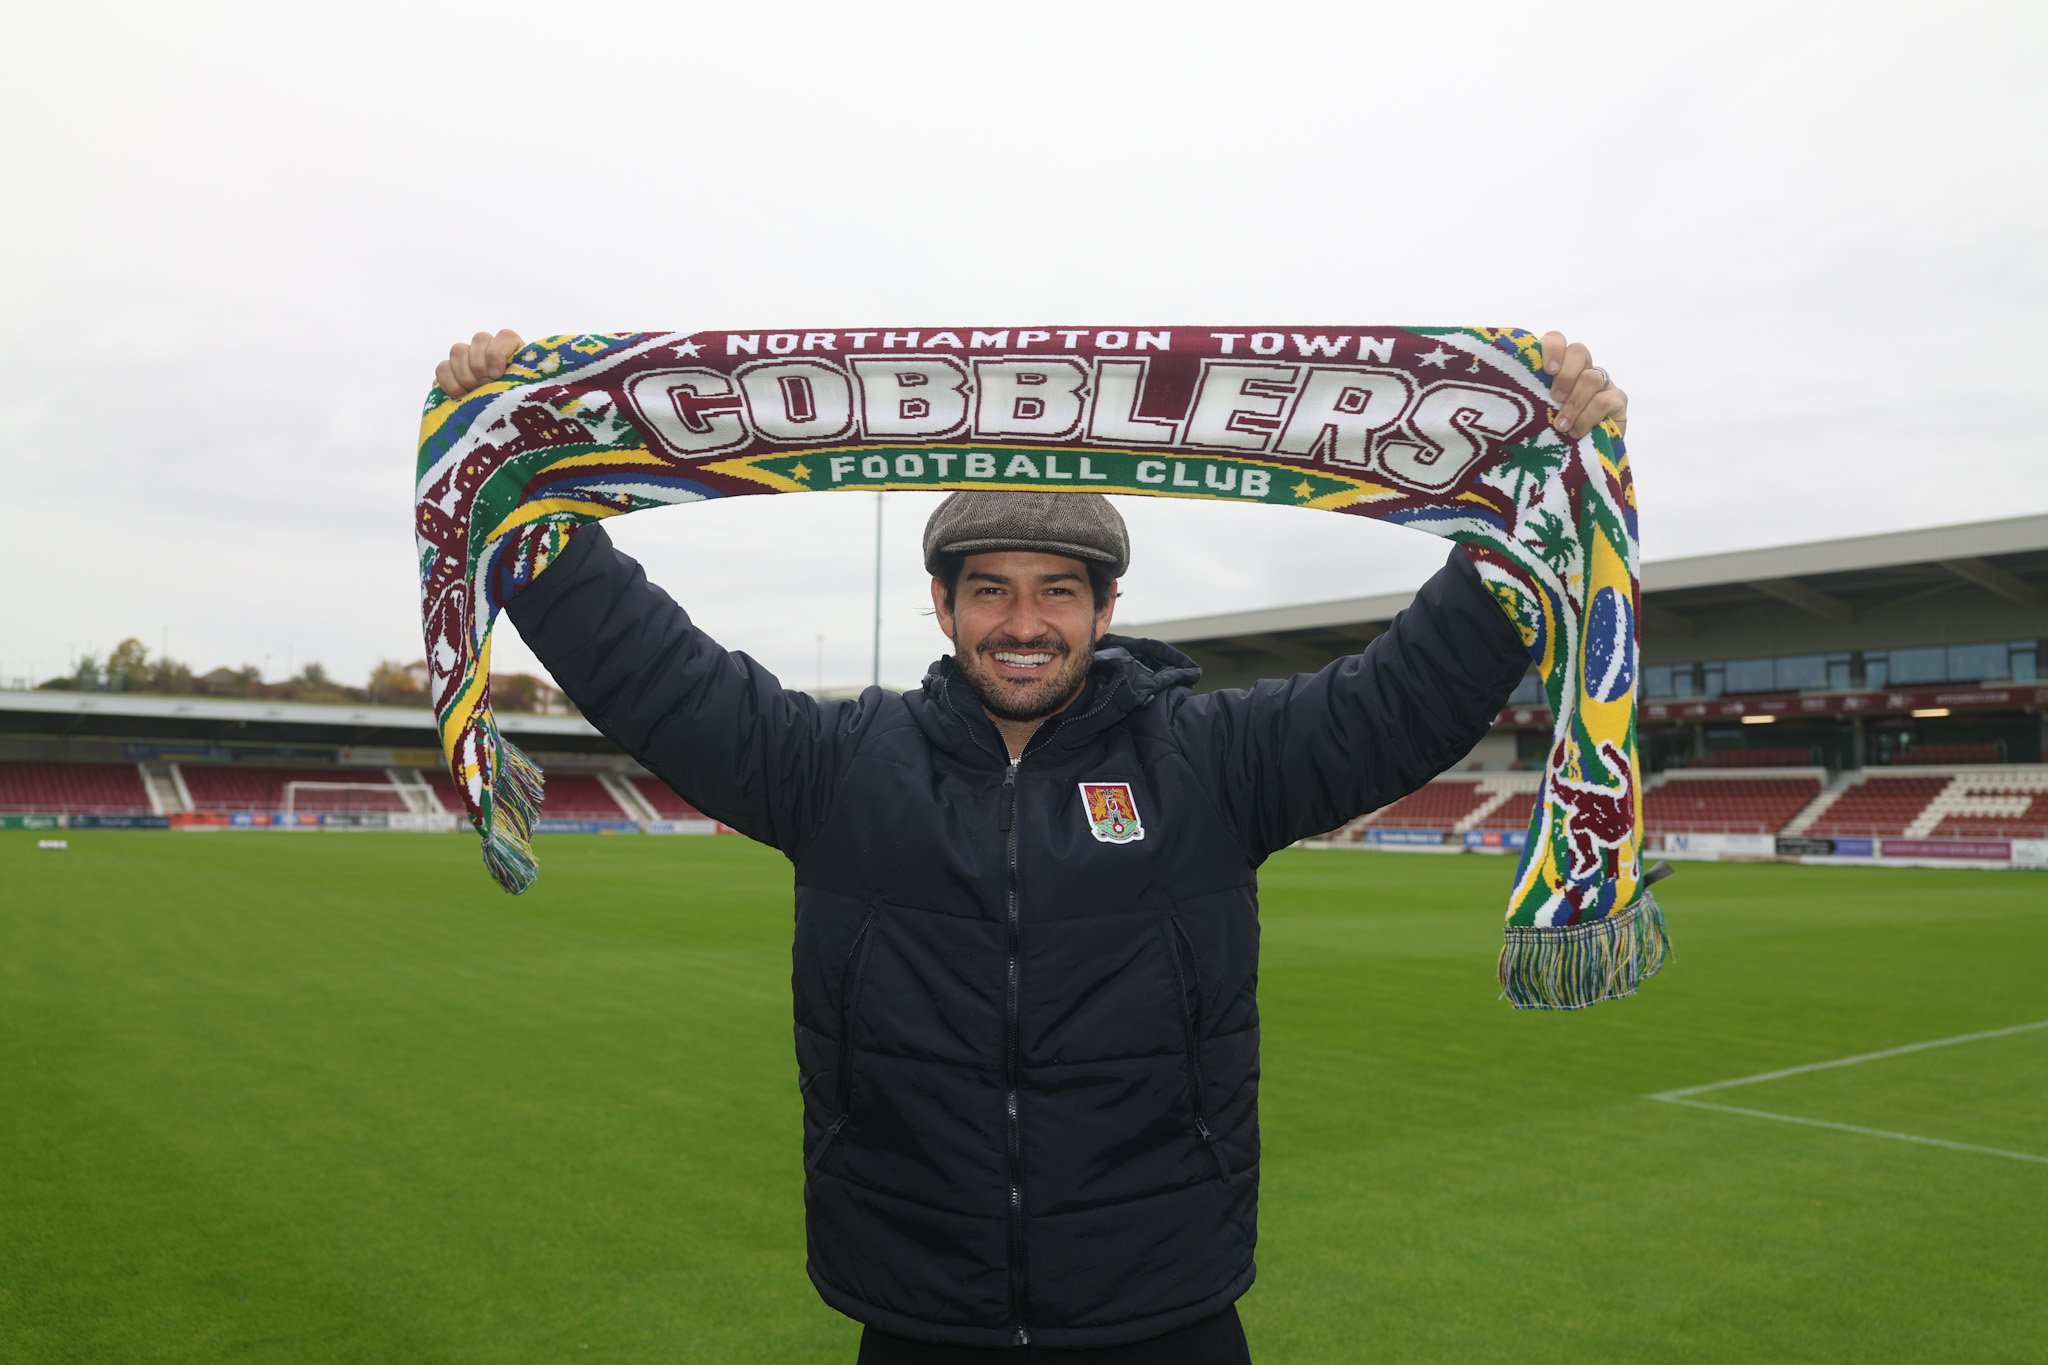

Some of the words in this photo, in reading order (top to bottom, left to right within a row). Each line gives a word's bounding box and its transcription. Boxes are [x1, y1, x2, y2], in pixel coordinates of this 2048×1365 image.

[725, 329, 1172, 356] NORTHAMPTON
[1210, 332, 1395, 363] TOWN
[623, 355, 1535, 494] COBBLERS
[829, 453, 1108, 482] FOOTBALL
[1135, 461, 1272, 497] CLUB
